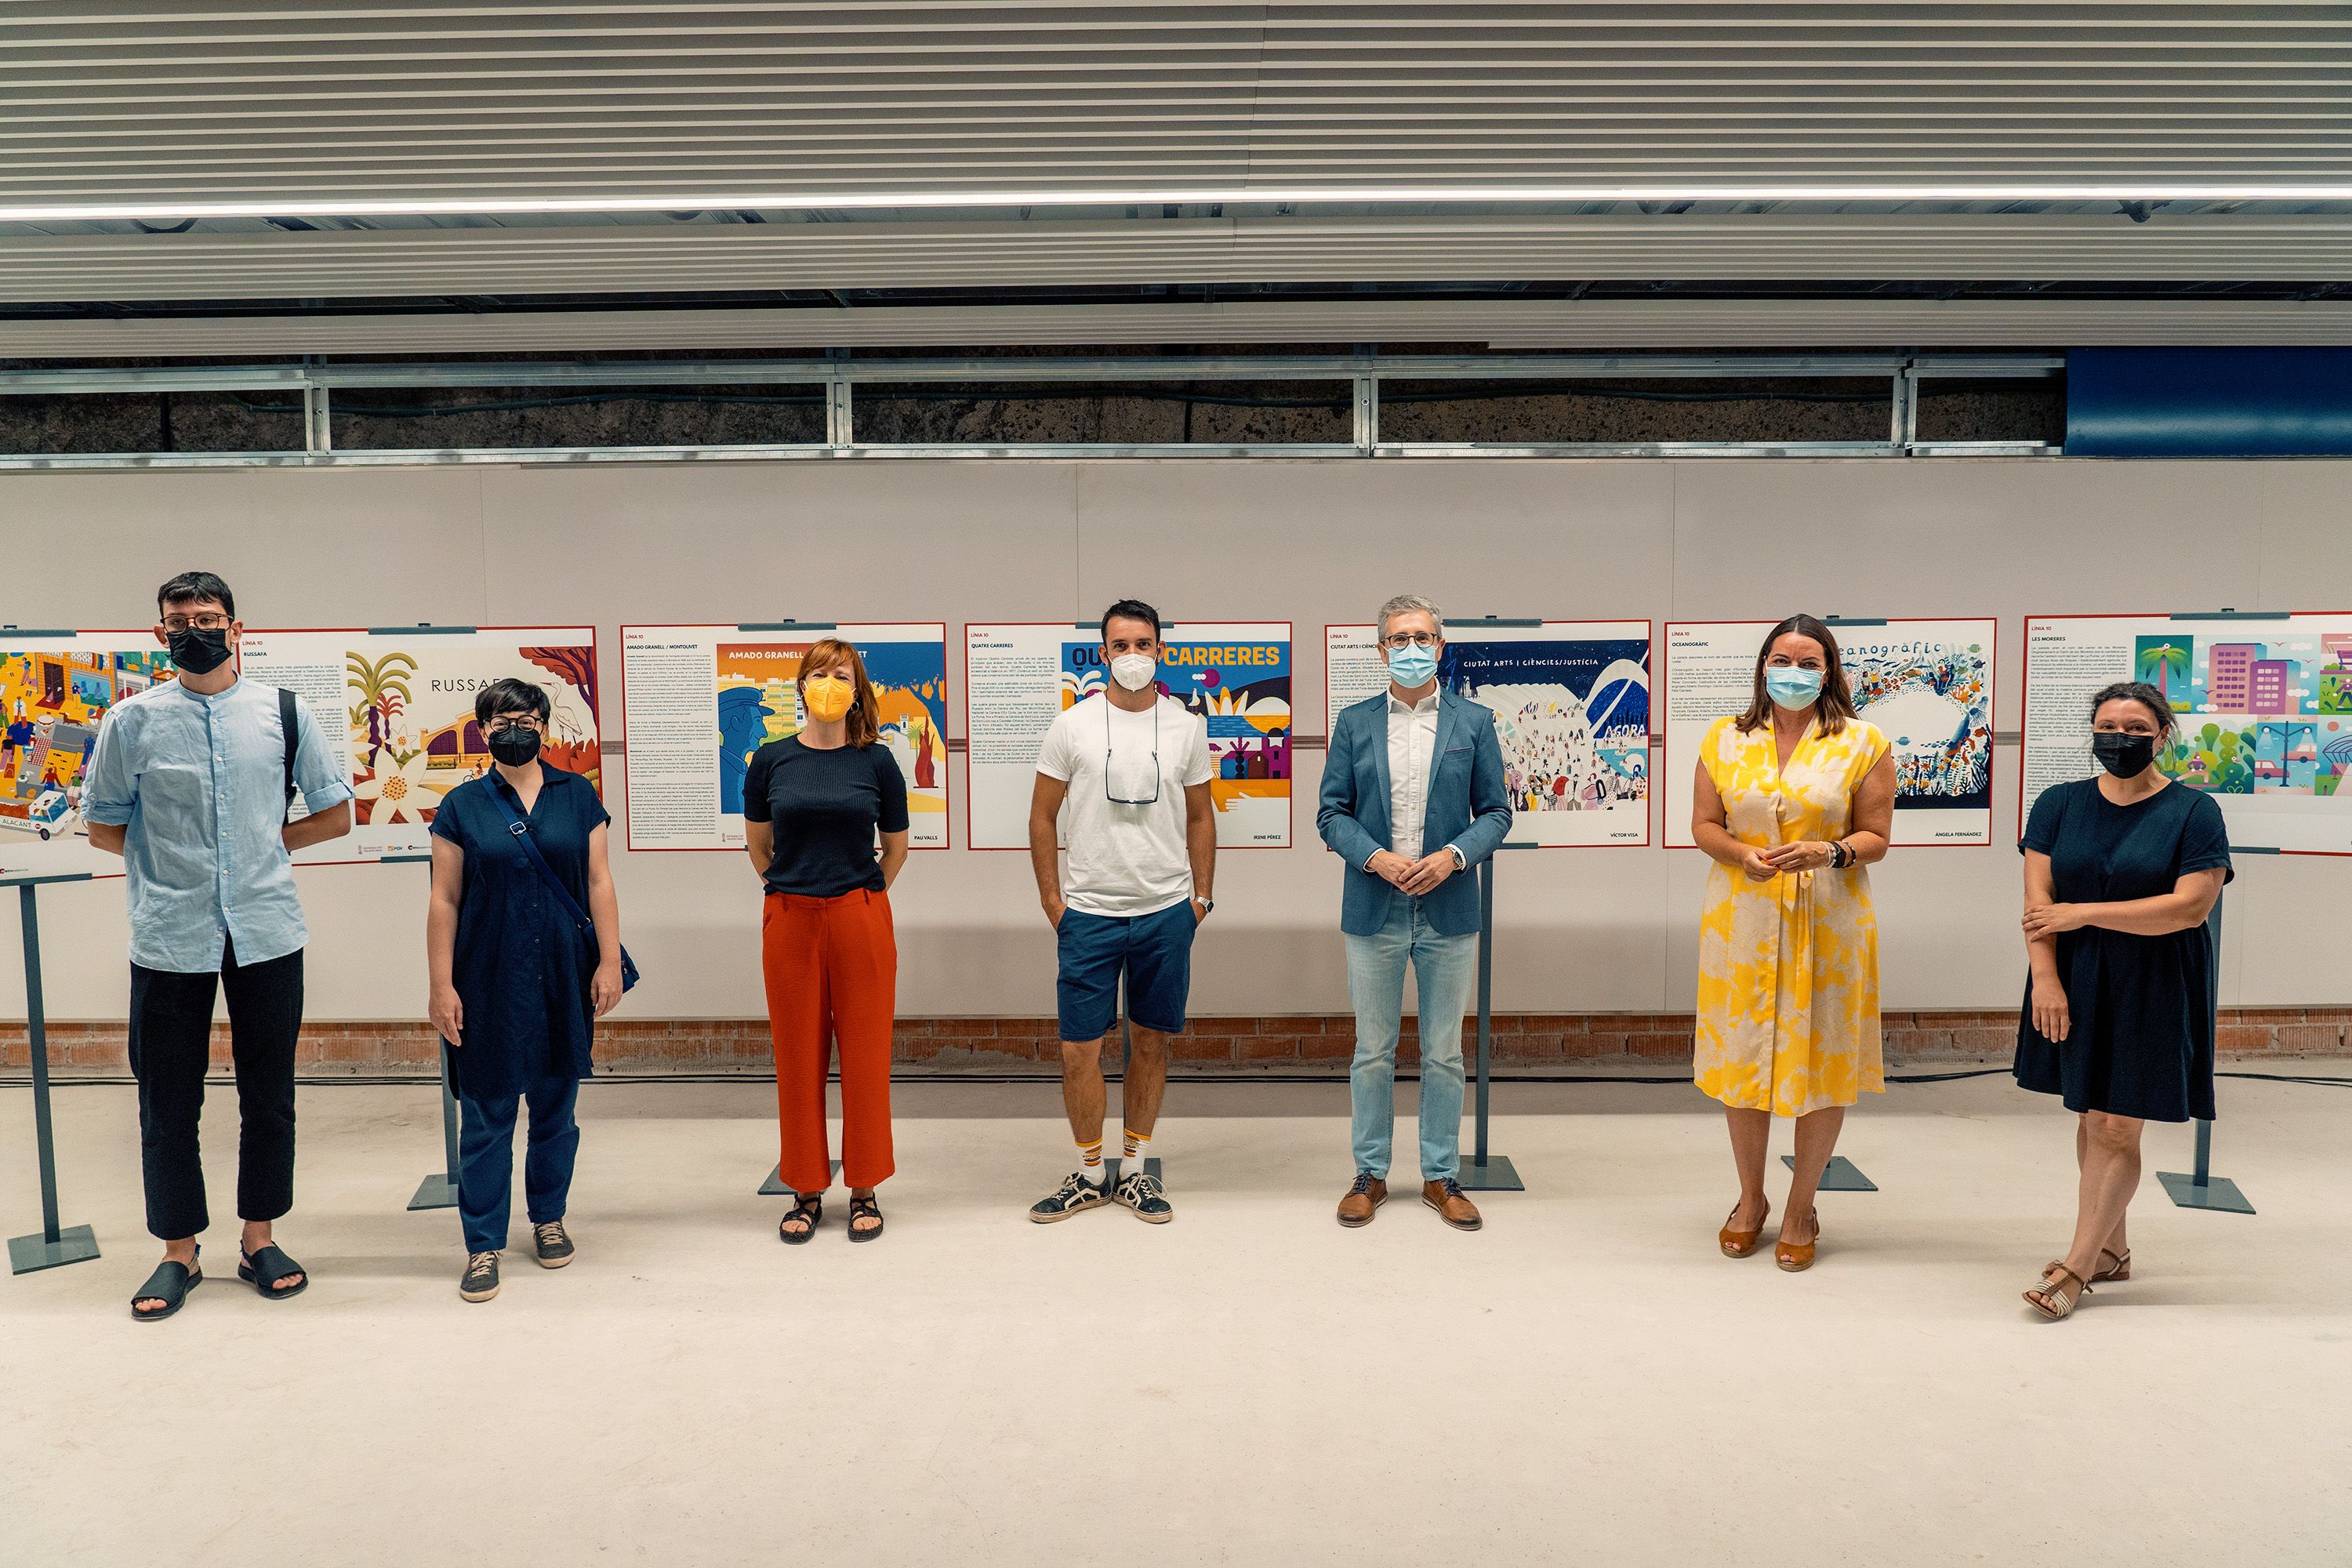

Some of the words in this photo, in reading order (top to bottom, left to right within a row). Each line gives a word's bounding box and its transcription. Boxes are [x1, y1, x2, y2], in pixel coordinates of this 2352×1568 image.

[1164, 647, 1280, 666] CARRERES
[1838, 641, 1941, 658] eanogràfic
[431, 678, 500, 691] RUSSA
[2, 818, 31, 828] ALACANT
